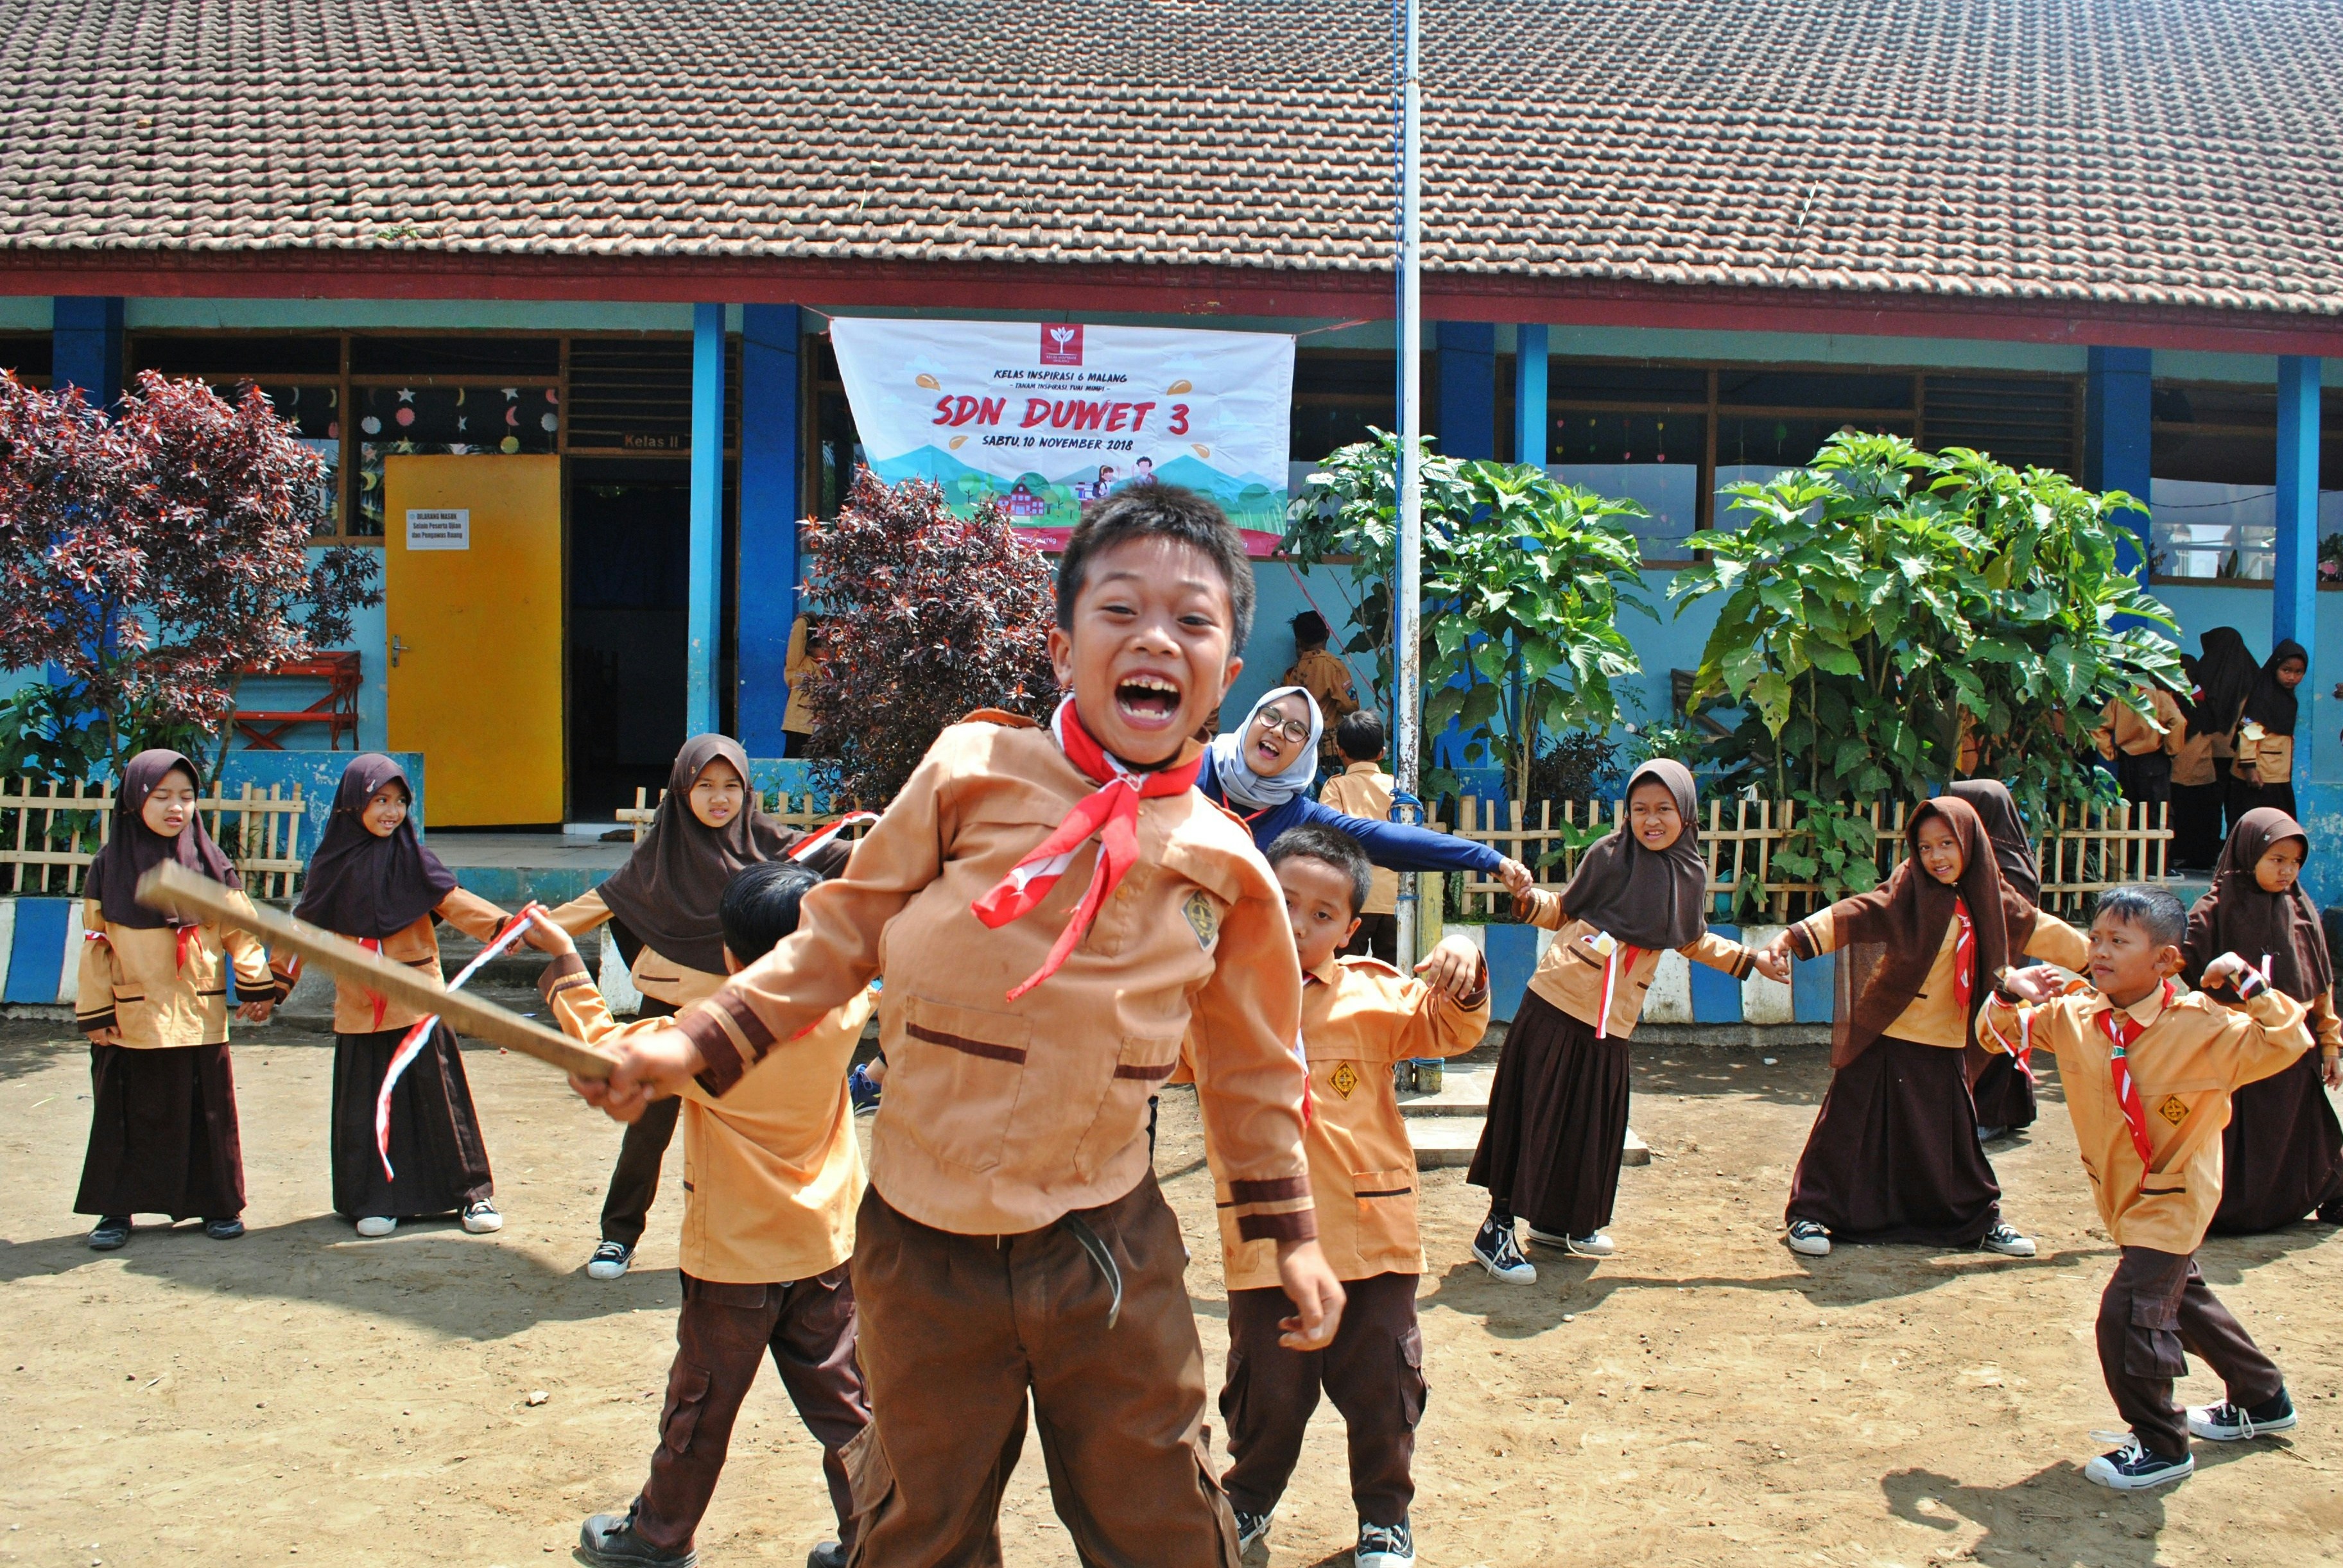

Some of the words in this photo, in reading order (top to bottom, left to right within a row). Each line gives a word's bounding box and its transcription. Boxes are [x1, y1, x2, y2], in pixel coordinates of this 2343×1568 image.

[994, 370, 1024, 379] KELAS
[1027, 370, 1075, 381] INSPIRASI
[1078, 373, 1084, 381] 6
[1087, 372, 1128, 383] MALANG
[933, 394, 1007, 427] SDN
[1017, 397, 1156, 433] DUWET
[1167, 404, 1190, 435] 3
[625, 435, 664, 447] Kelas
[670, 436, 679, 447] II
[1023, 436, 1035, 447] 10
[1039, 437, 1103, 449] NOVEMBER
[1106, 440, 1134, 451] 2018
